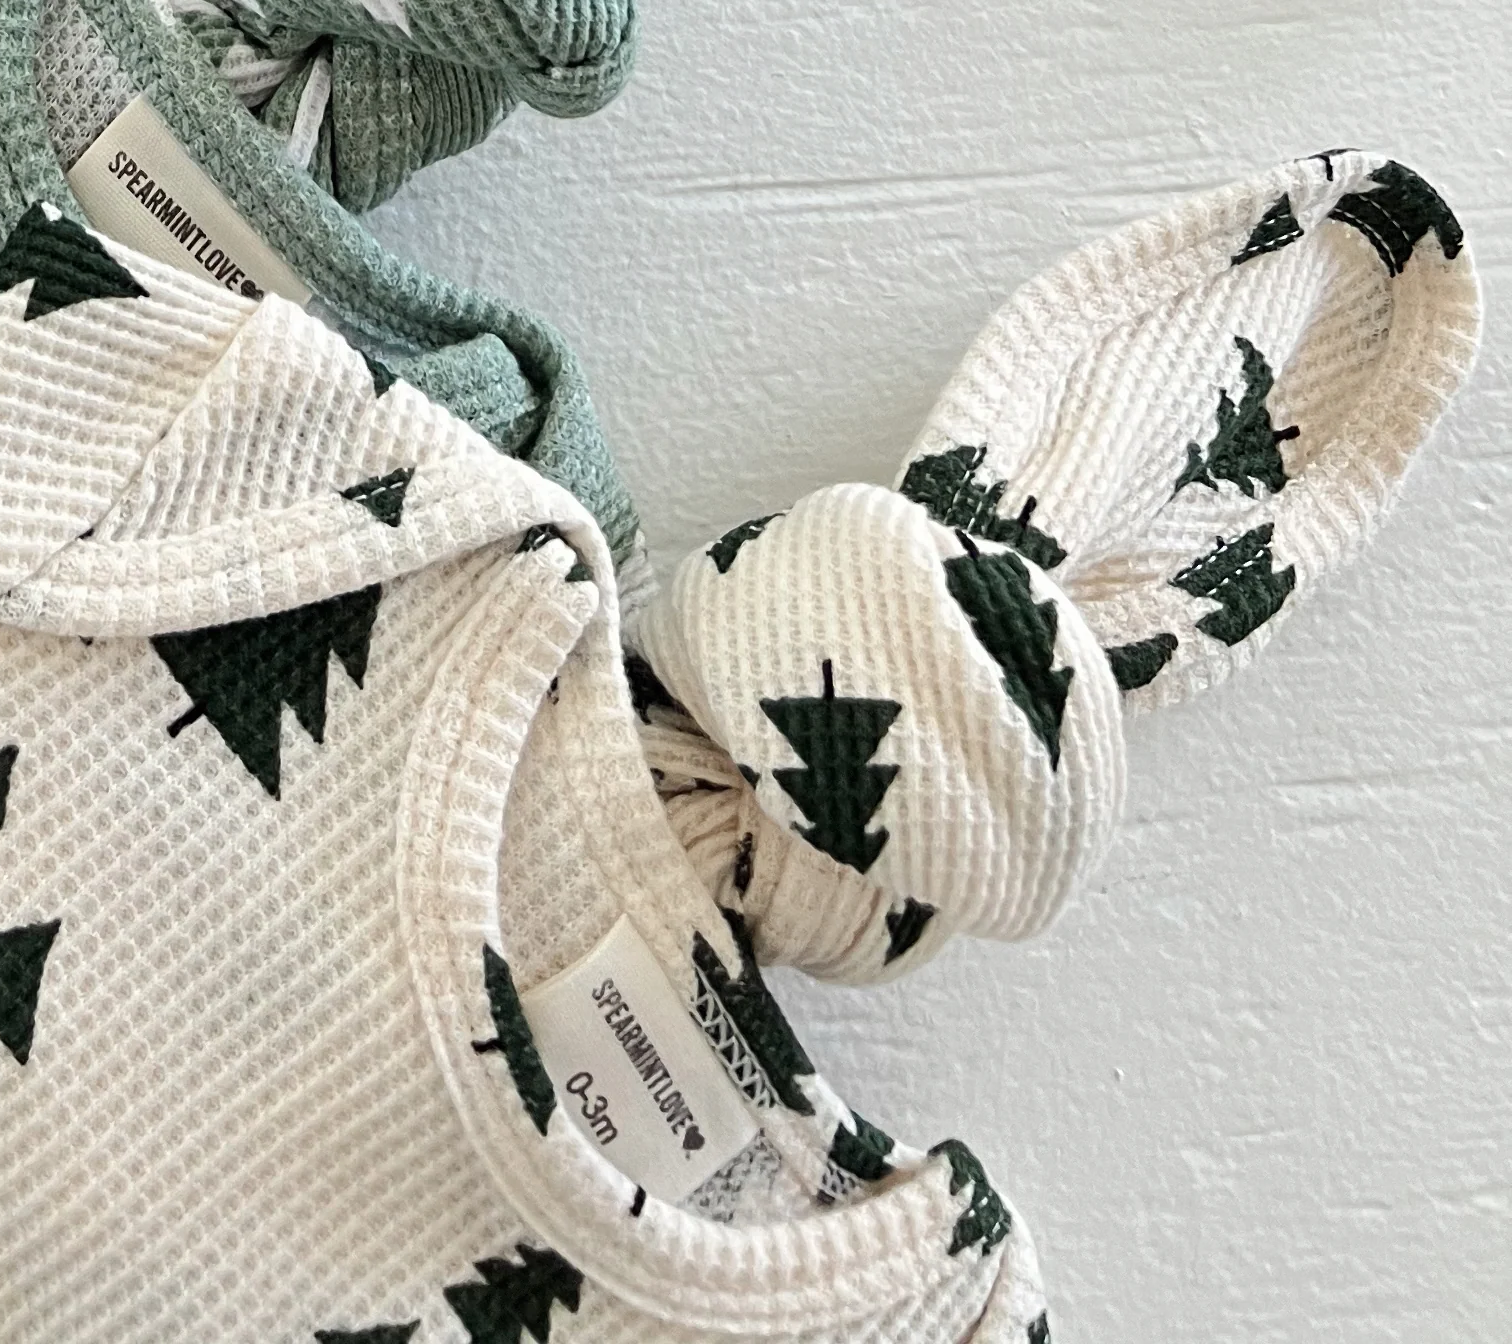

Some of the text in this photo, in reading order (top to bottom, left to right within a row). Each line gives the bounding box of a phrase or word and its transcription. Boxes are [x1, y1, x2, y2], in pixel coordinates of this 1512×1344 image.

[108, 151, 246, 291] SPEARMINTLOVE
[566, 1072, 618, 1146] 0-3m
[591, 978, 694, 1135] SPEARMINTLOVE
